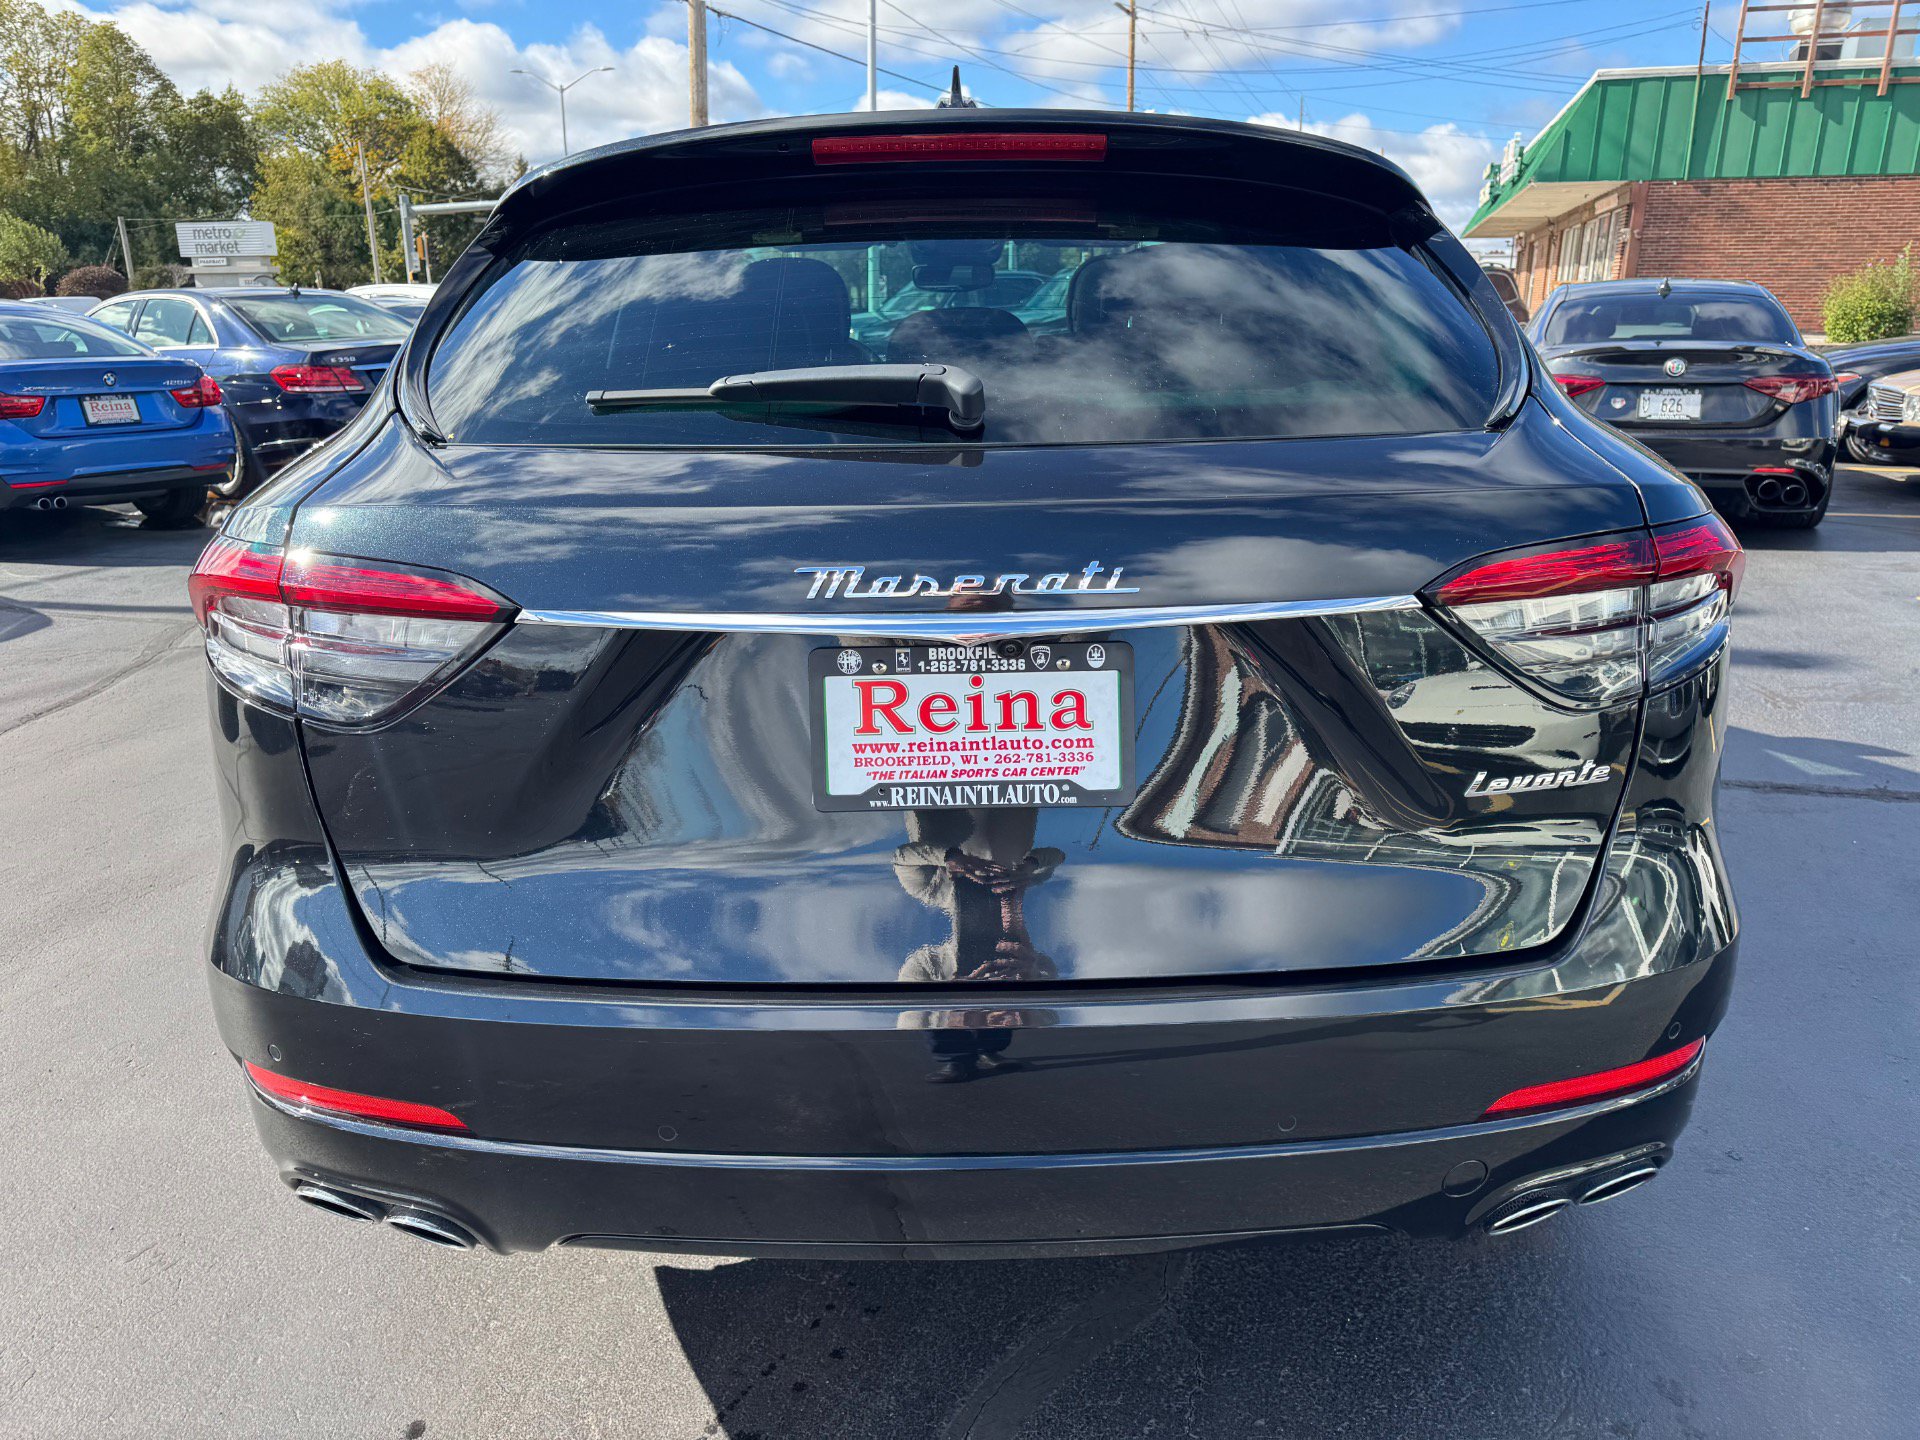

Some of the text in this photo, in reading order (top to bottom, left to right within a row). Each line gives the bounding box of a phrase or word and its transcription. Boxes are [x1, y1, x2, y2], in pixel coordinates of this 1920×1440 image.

[192, 226, 232, 240] metro
[194, 240, 241, 254] market
[89, 401, 132, 412] Reina
[1661, 398, 1683, 413] 626
[794, 560, 1141, 599] Maserati
[917, 659, 1026, 673] 1-262-781-3336
[852, 673, 1095, 737] Reina
[852, 736, 1095, 755] www.reinaintlauto.com
[854, 751, 1094, 768] BROOKFIELD, WI 262-781-3336
[899, 770, 948, 780] ITALIAN
[950, 768, 999, 779] SPORTS
[1002, 767, 1027, 778] CAR
[1464, 759, 1612, 798] Levante
